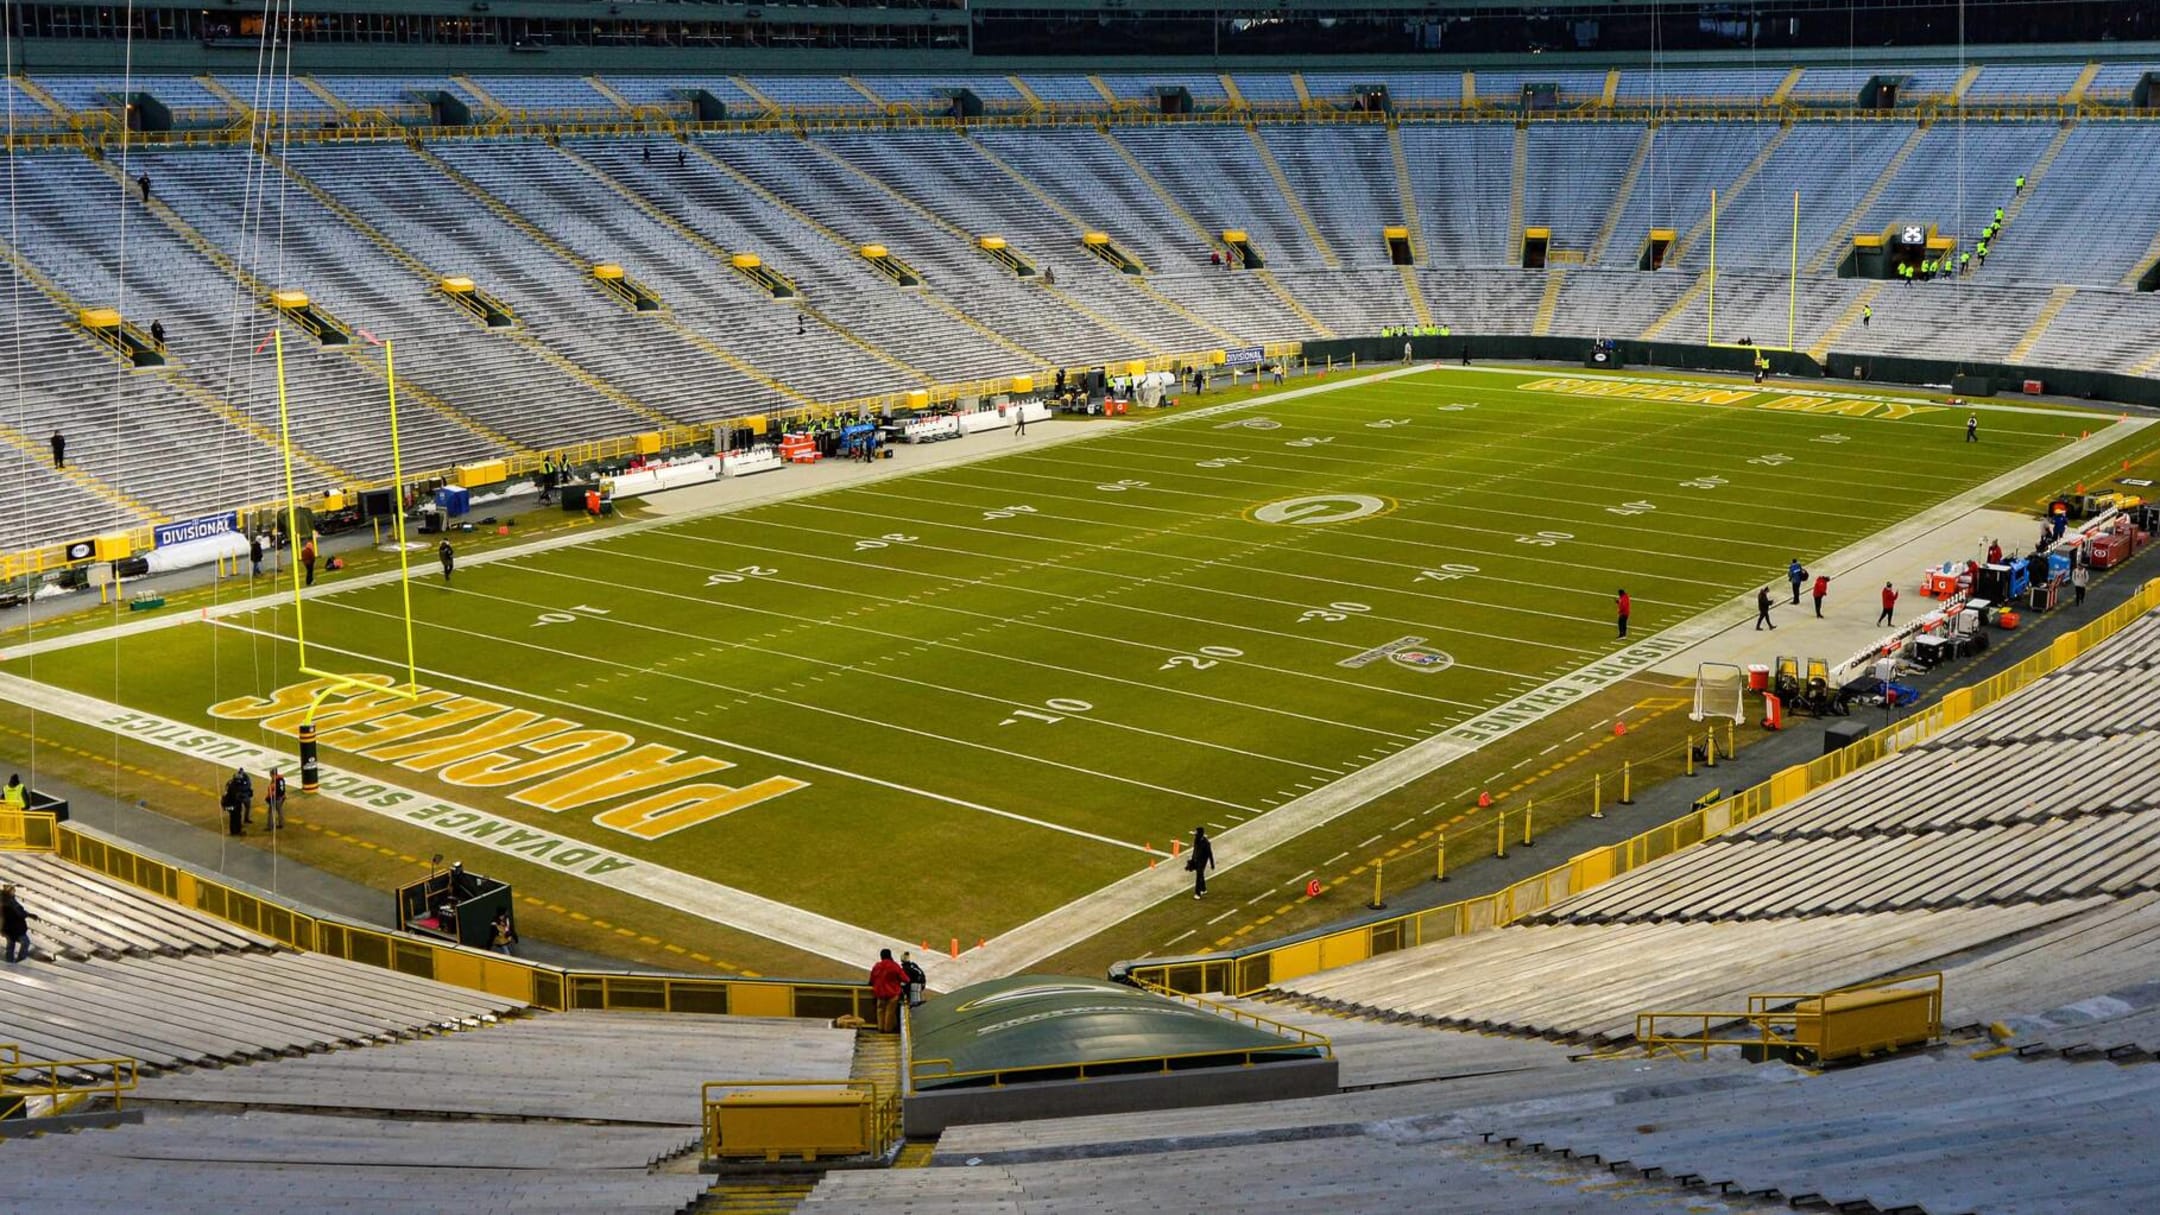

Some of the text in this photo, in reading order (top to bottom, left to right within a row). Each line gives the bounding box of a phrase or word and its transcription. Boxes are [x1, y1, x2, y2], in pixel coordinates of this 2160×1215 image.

[1227, 350, 1262, 362] DIVISIONAL
[1517, 378, 1760, 405] GREEN
[1757, 395, 1949, 420] BAY
[1096, 479, 1151, 492] 50
[990, 504, 1038, 519] 40
[1606, 502, 1657, 515] 40
[163, 519, 231, 545] DIVISIONAL
[859, 533, 919, 550] 30
[1516, 530, 1575, 546] 50
[708, 565, 778, 584] 20
[1422, 563, 1480, 581] 40
[538, 603, 611, 624] 10
[1303, 601, 1372, 622] 30
[1168, 645, 1244, 670] 20
[1451, 638, 1687, 742] INSPIRE CHANGE
[1013, 697, 1094, 724] 10
[101, 713, 265, 759] JUSTICE
[207, 673, 812, 841] PACKERS
[406, 803, 636, 875] ADVANCE
[1311, 880, 1320, 893] G
